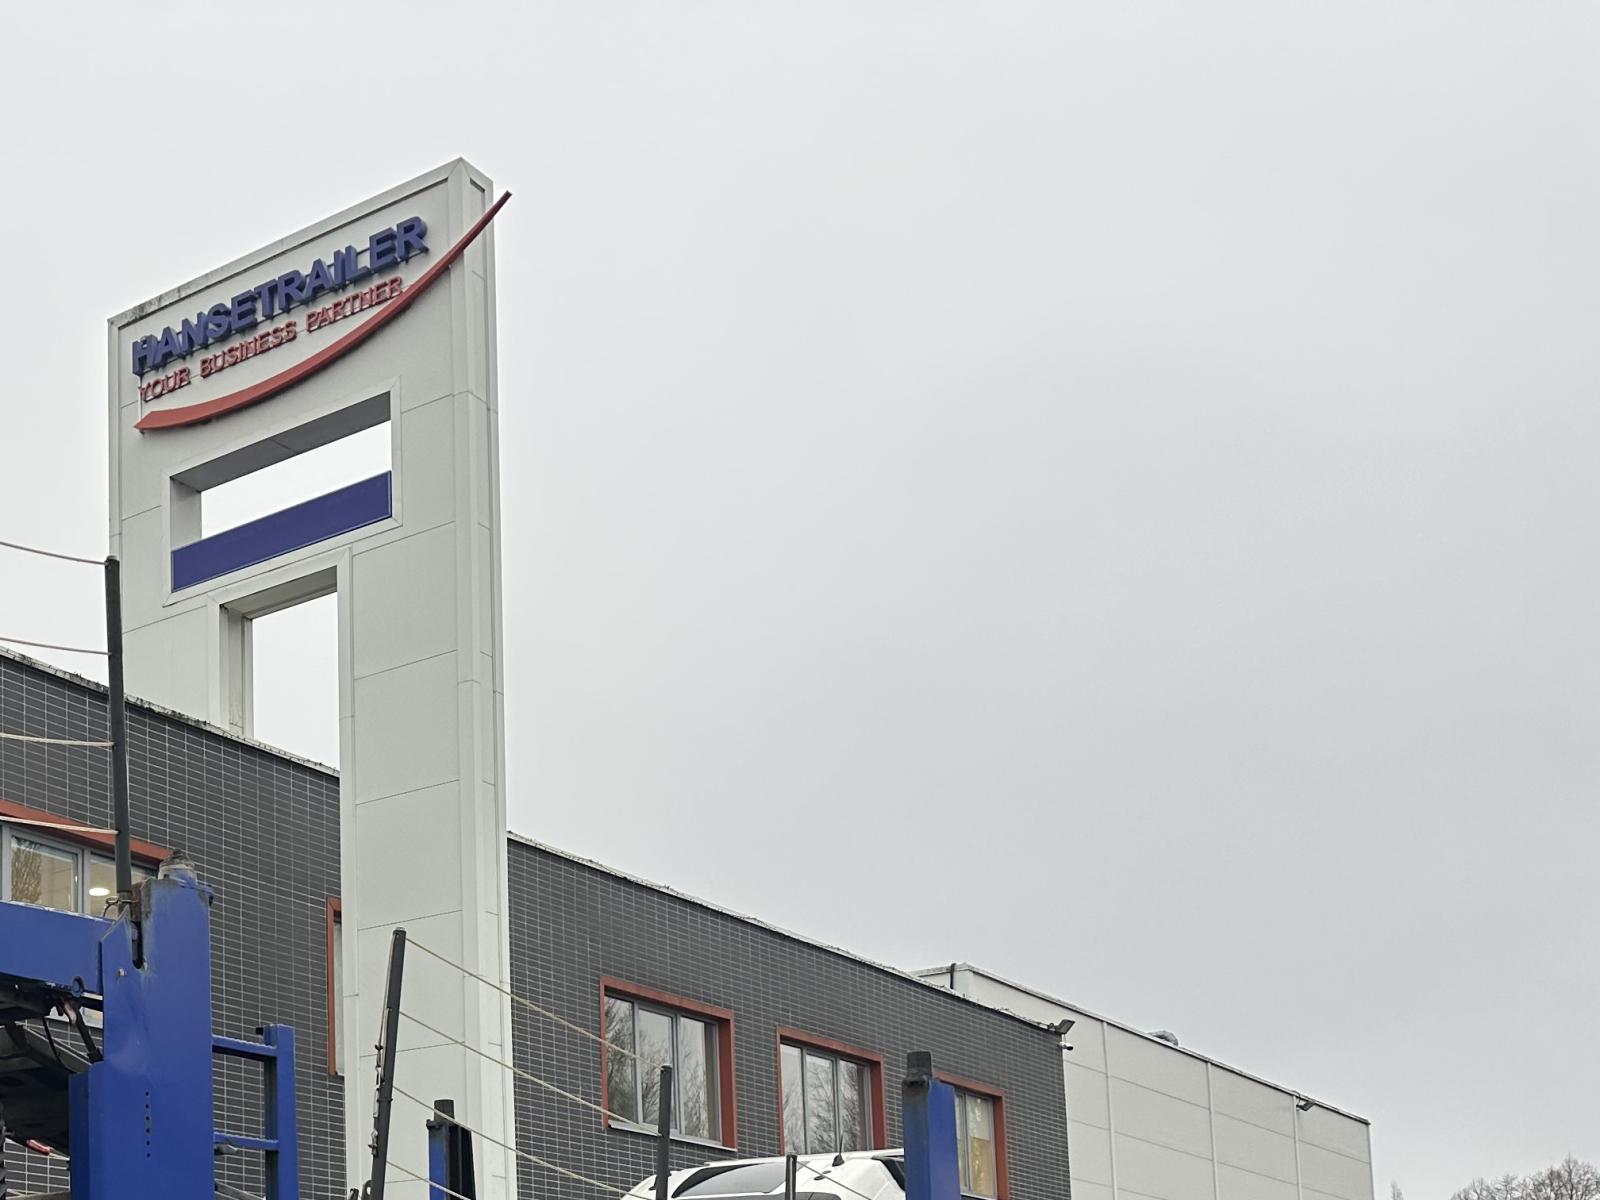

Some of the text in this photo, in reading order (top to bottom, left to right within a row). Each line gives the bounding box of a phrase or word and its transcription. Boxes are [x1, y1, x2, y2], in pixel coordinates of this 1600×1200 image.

[132, 216, 429, 376] HANSETRAILER
[139, 276, 404, 402] YOUR BUSINESS PARTNER
